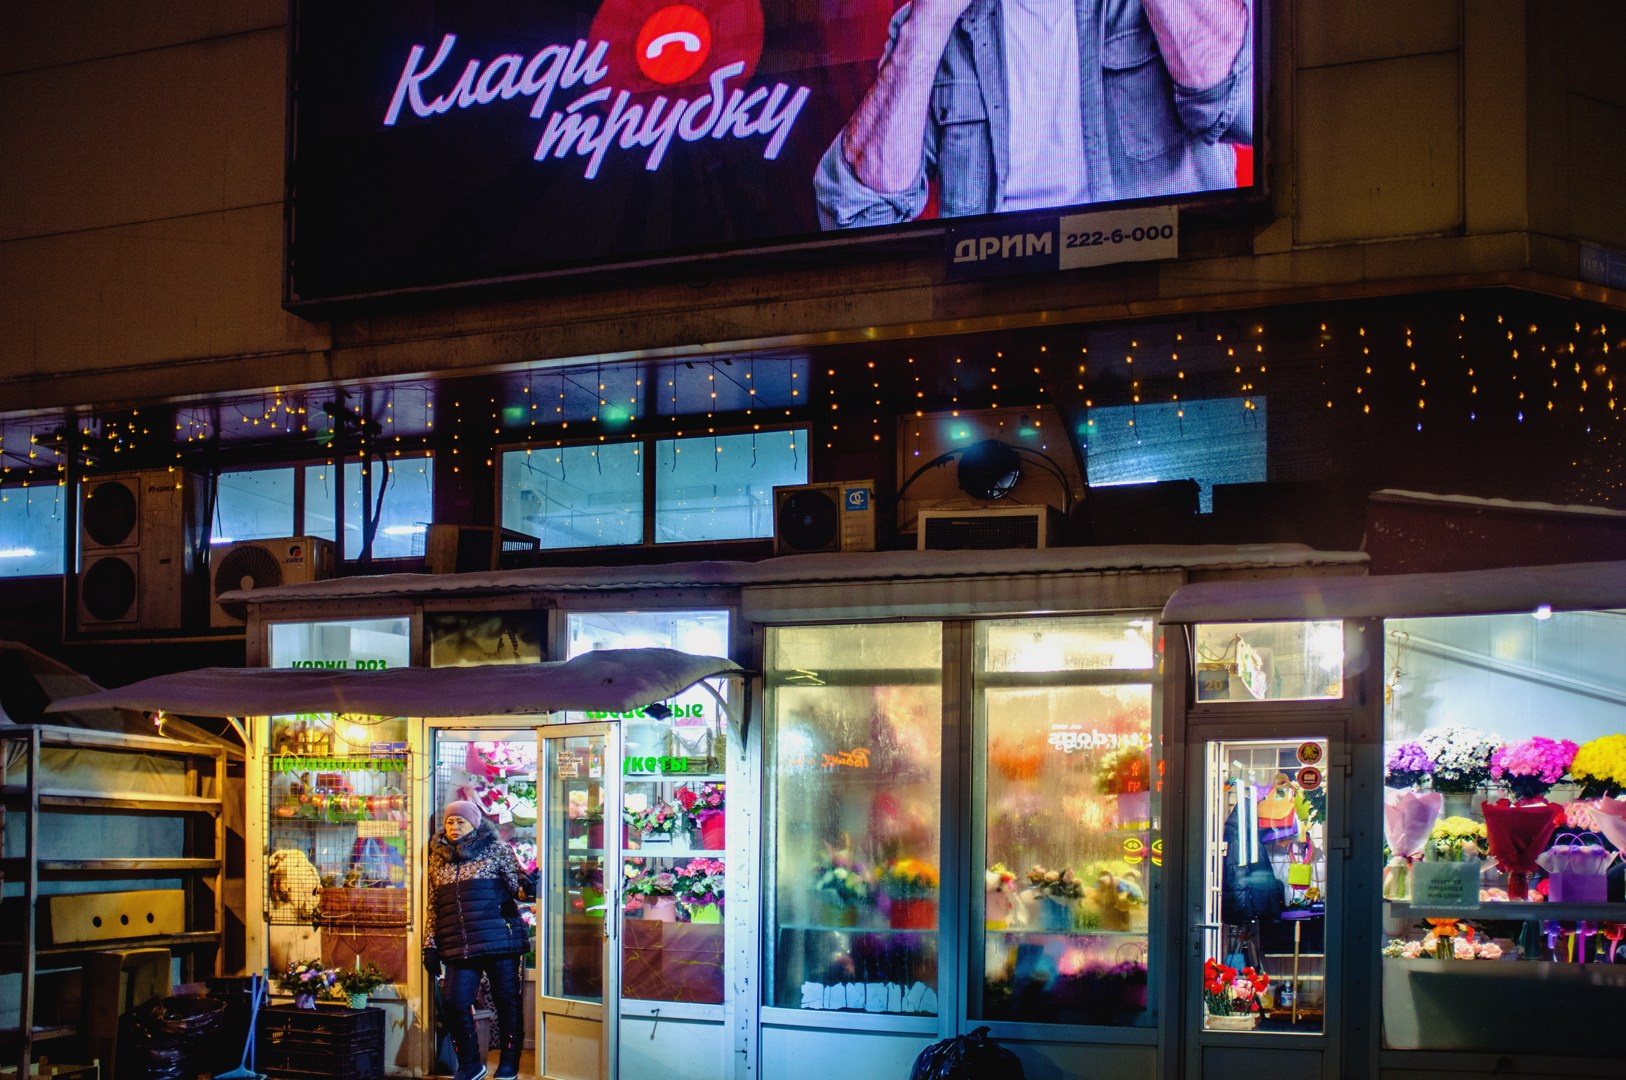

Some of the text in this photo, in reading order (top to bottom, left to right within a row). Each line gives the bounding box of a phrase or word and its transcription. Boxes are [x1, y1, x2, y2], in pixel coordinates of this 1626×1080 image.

[384, 33, 609, 126] Клади
[533, 61, 811, 180] трубку
[953, 231, 1053, 263] ДРИМ
[1065, 224, 1174, 249] 222-6-000
